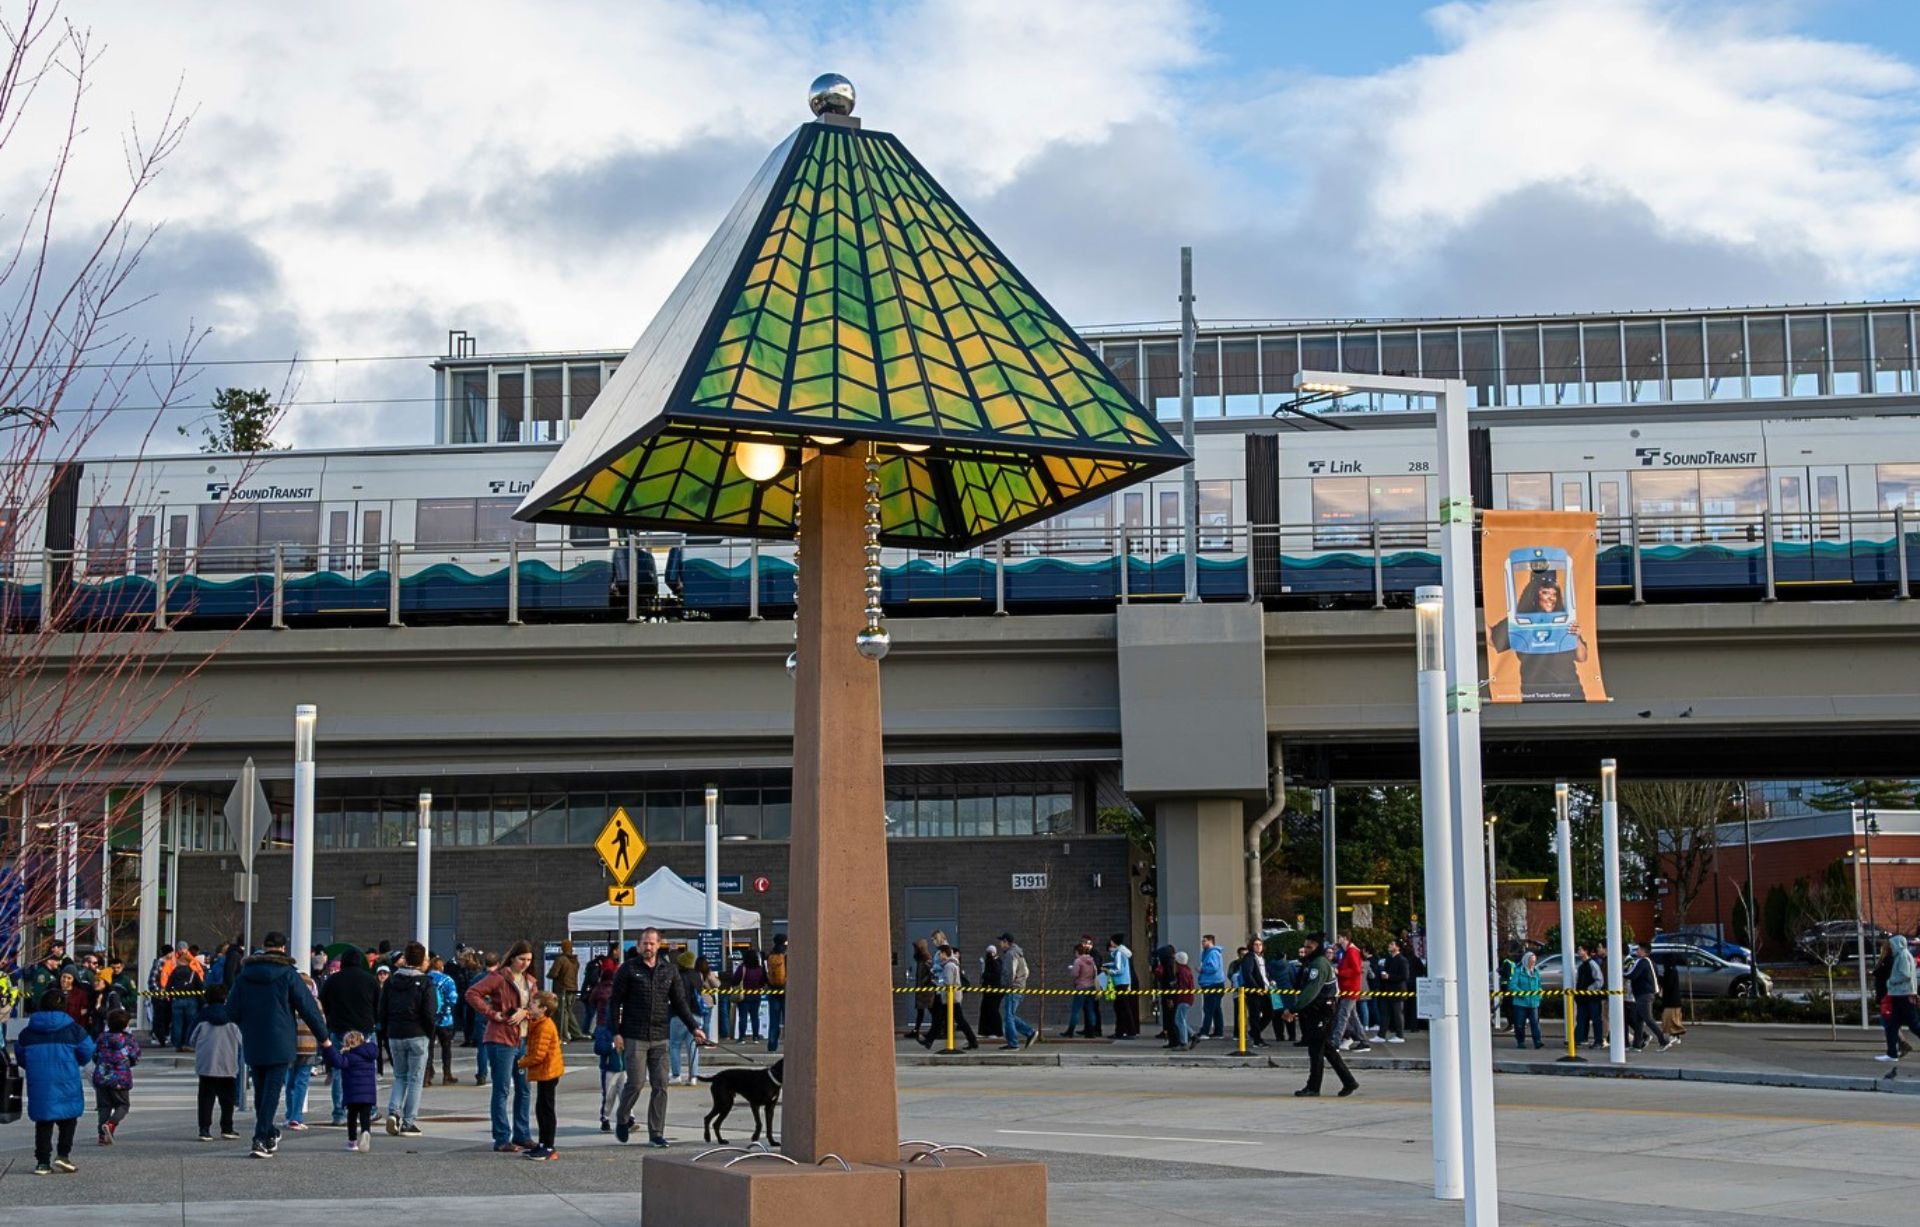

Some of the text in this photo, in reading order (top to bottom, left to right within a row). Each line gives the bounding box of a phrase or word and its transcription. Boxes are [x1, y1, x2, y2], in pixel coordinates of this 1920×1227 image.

[1663, 450, 1757, 466] SOUNDTRANSIT
[1330, 460, 1362, 473] Link
[1408, 461, 1430, 472] 288
[1014, 875, 1046, 888] 31911
